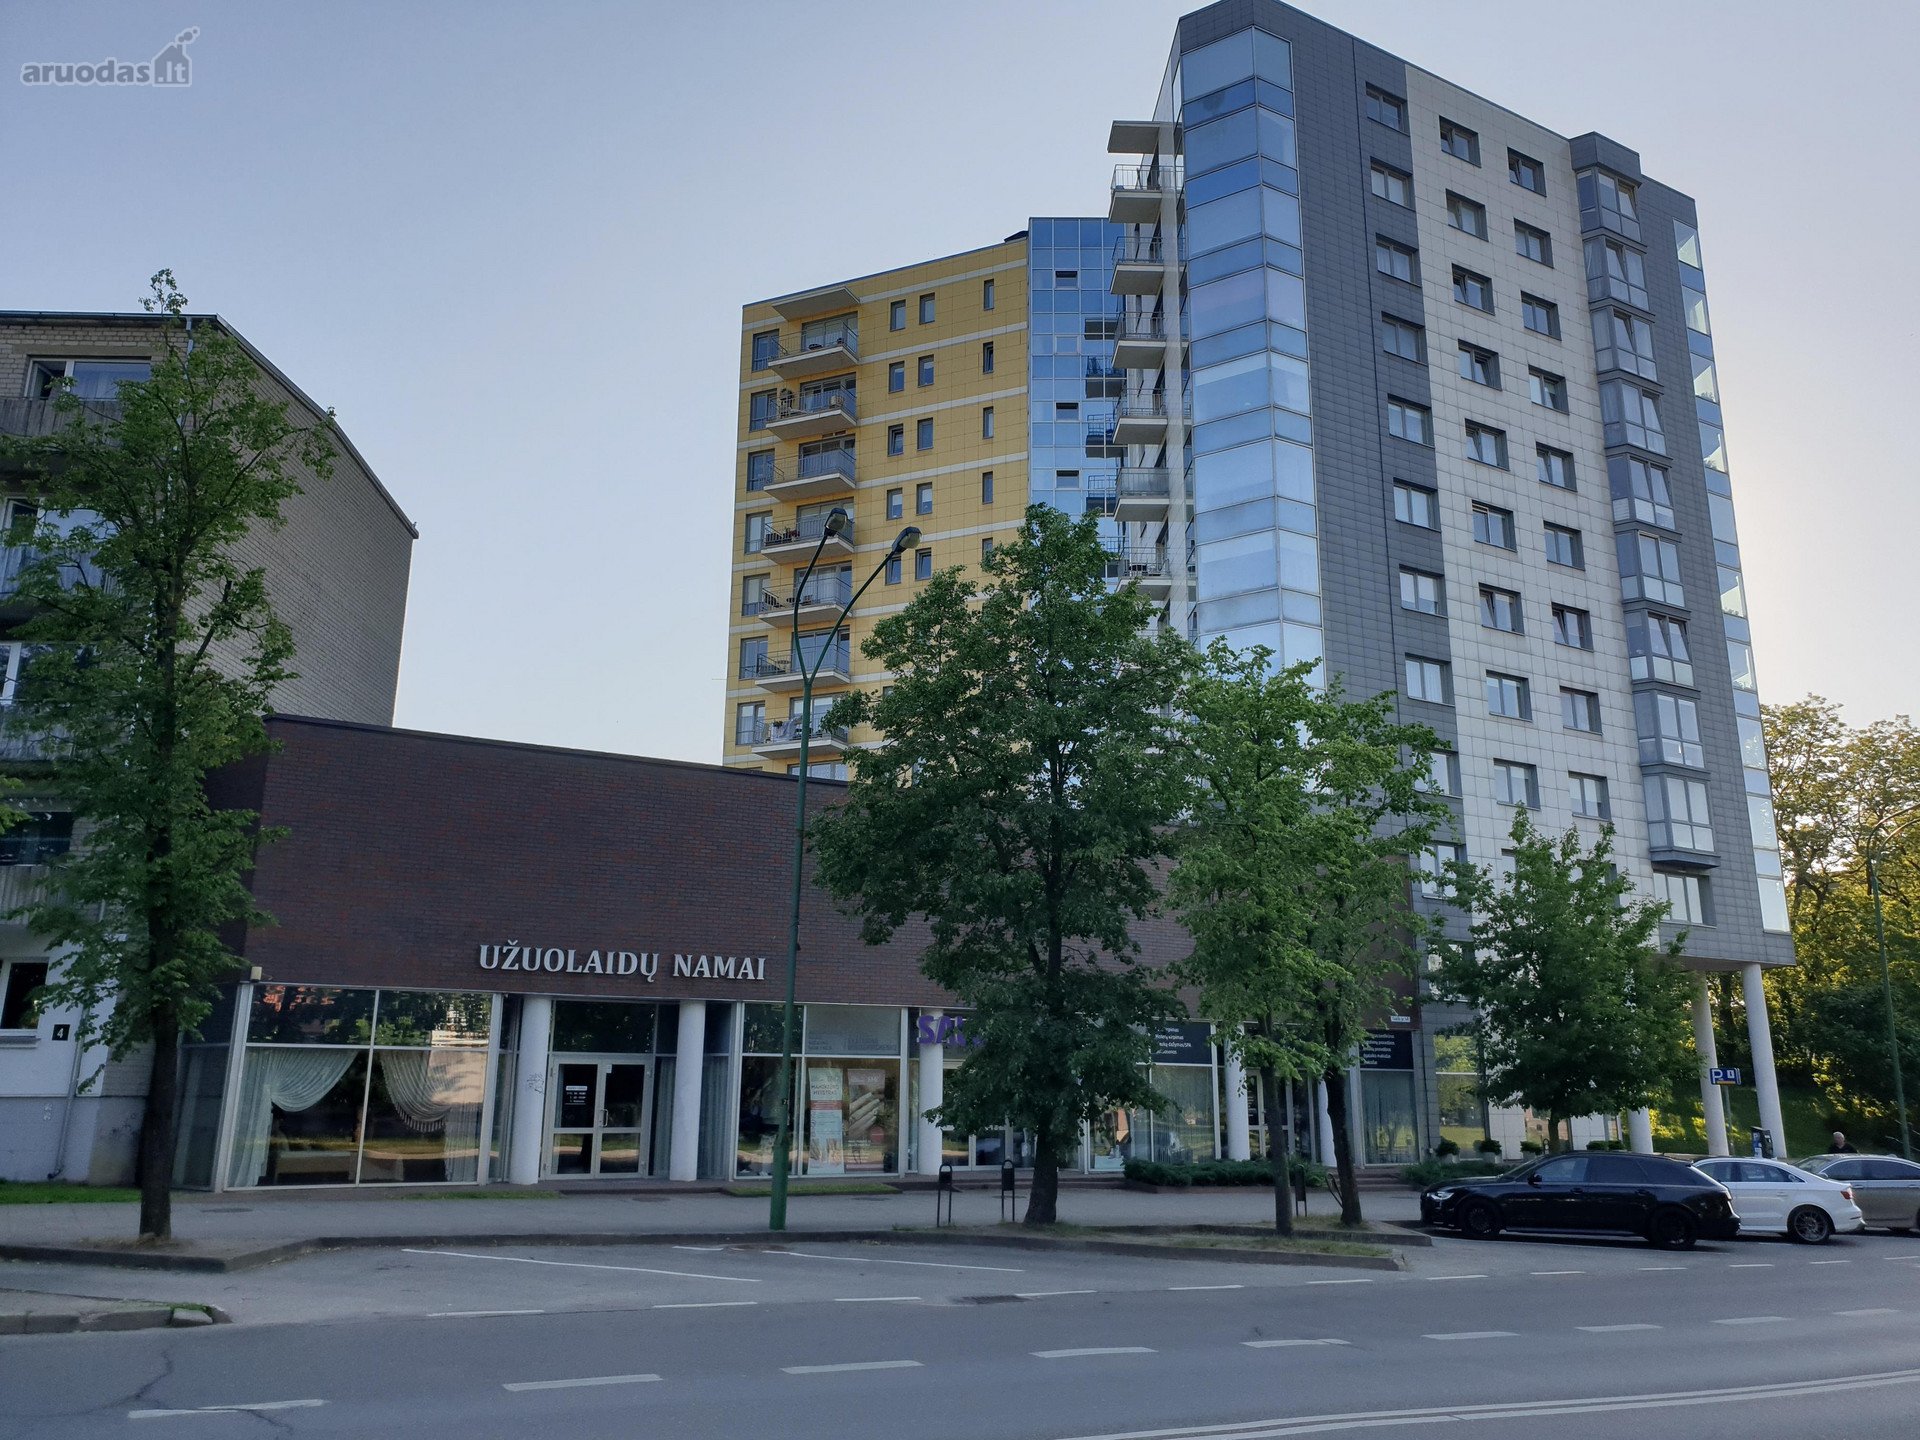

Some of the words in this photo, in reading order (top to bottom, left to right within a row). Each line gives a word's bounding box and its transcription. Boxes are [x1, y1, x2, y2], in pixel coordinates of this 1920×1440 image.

[479, 939, 659, 983] UŽUOLAIDŲ
[672, 953, 766, 981] NAMAI
[57, 1028, 63, 1038] 4
[1711, 1069, 1723, 1084] P
